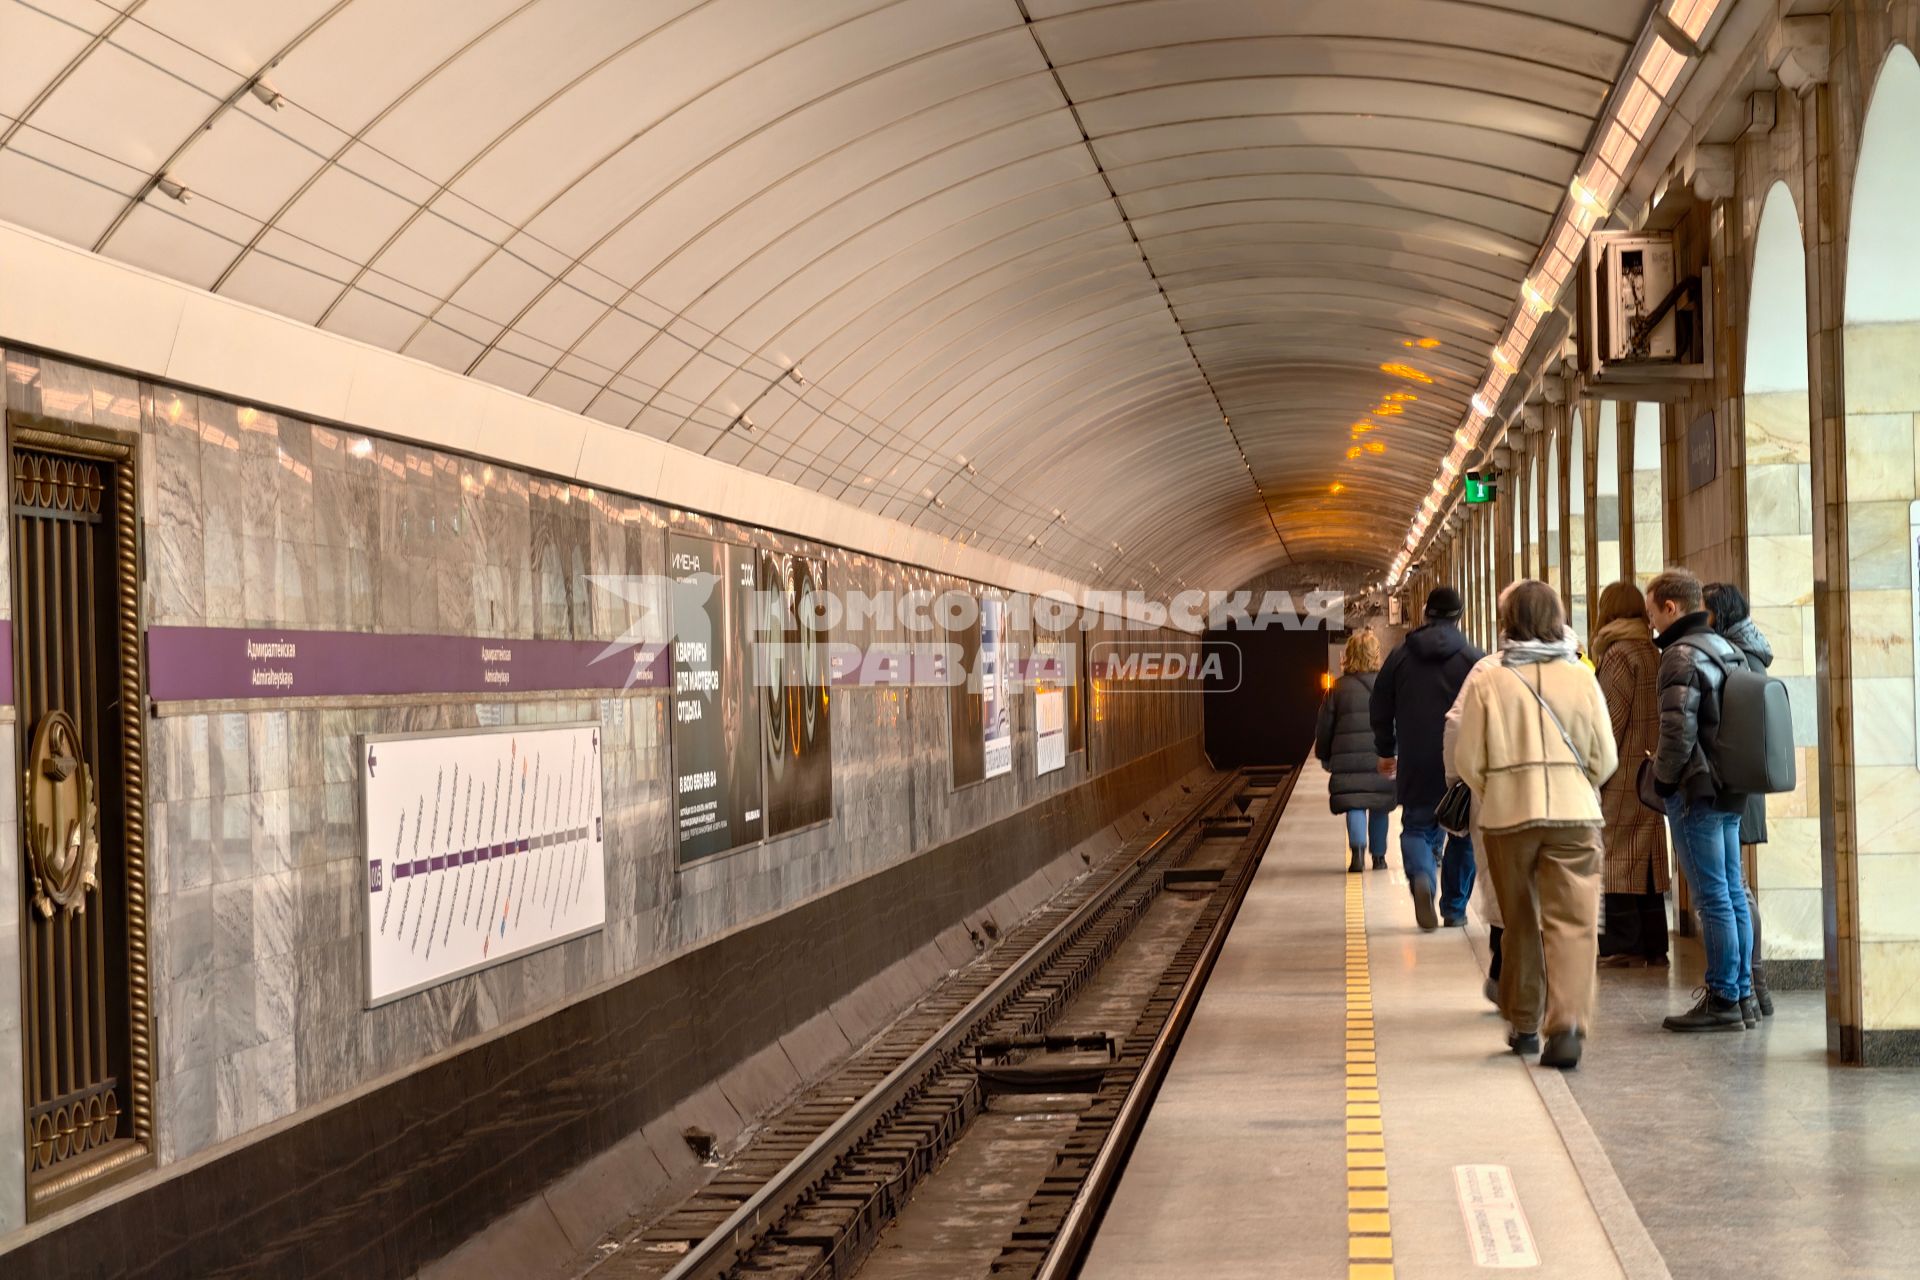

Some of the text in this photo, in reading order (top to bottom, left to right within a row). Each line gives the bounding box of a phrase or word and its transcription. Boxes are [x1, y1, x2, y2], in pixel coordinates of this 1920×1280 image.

[247, 637, 296, 663] Адмиралтейская
[676, 641, 707, 662] КВАРТИРЫ
[677, 671, 689, 695] ДЛЯ
[689, 670, 719, 692] МАСТЕРОВ
[678, 700, 702, 724] ОТДЫХА
